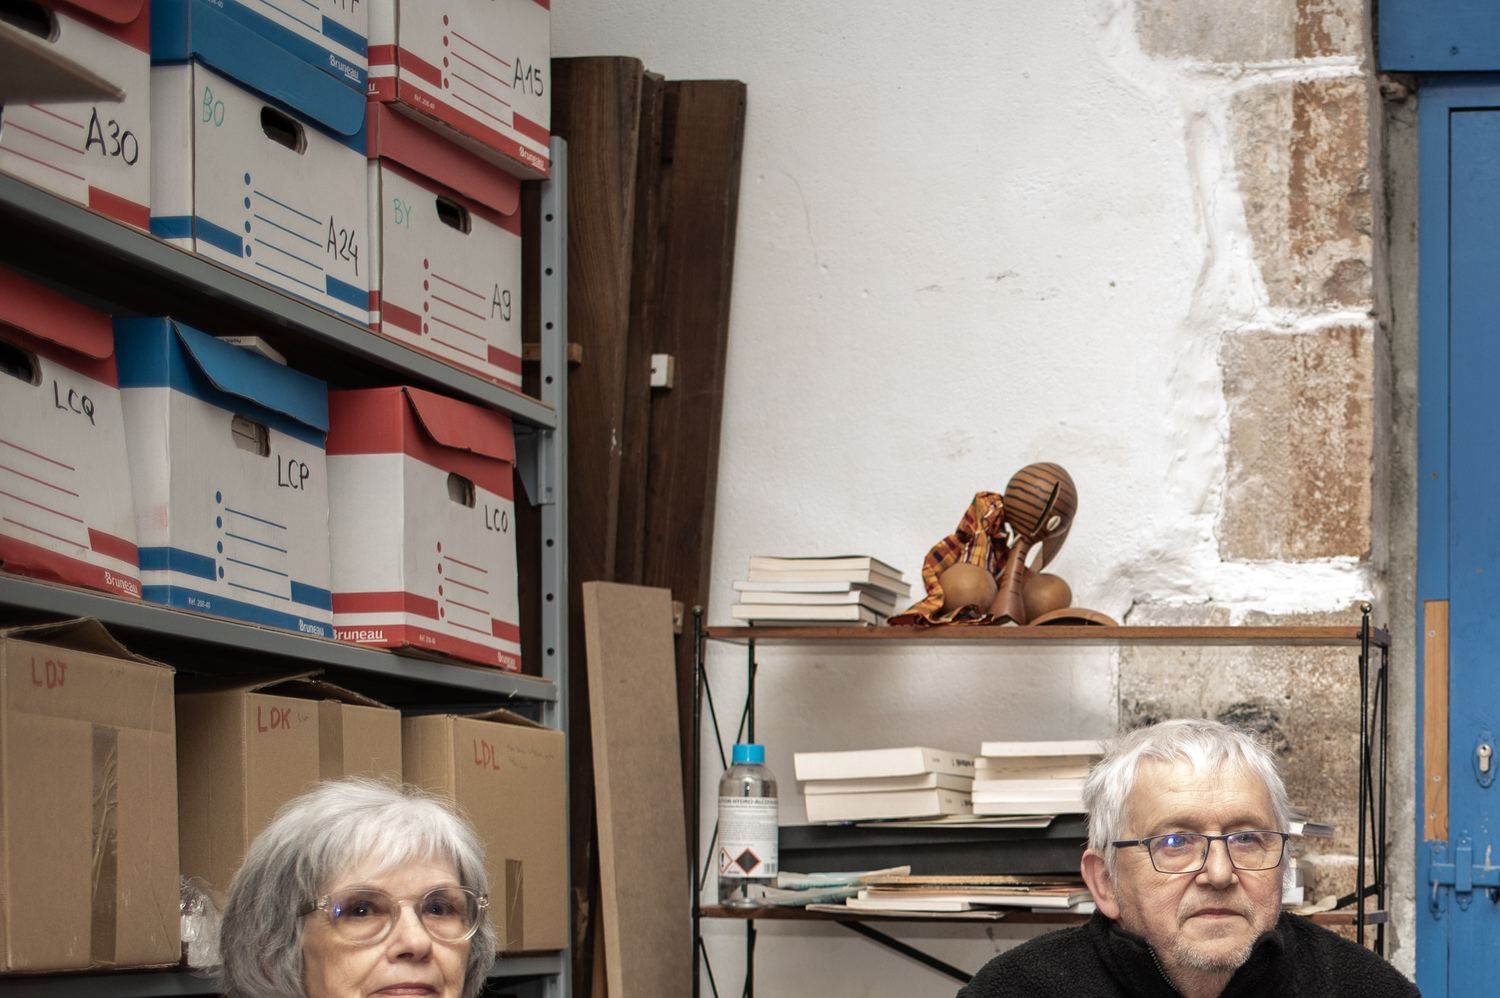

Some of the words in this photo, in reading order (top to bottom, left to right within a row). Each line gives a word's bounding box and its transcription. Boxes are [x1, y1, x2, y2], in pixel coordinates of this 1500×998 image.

[329, 54, 360, 80] Bruneau
[513, 57, 544, 97] A15
[85, 107, 139, 166] A30
[519, 146, 545, 168] Bruneau
[393, 198, 412, 229] BY
[326, 215, 359, 277] A24
[491, 283, 512, 322] A9
[53, 380, 96, 426] LCQ
[277, 454, 310, 491] LCP
[484, 503, 509, 533] LCO
[105, 571, 138, 594] Bruneau
[299, 619, 324, 637] Bruneau
[31, 656, 68, 690] LDJ
[257, 705, 291, 733] LDK
[473, 739, 501, 771] LDL
